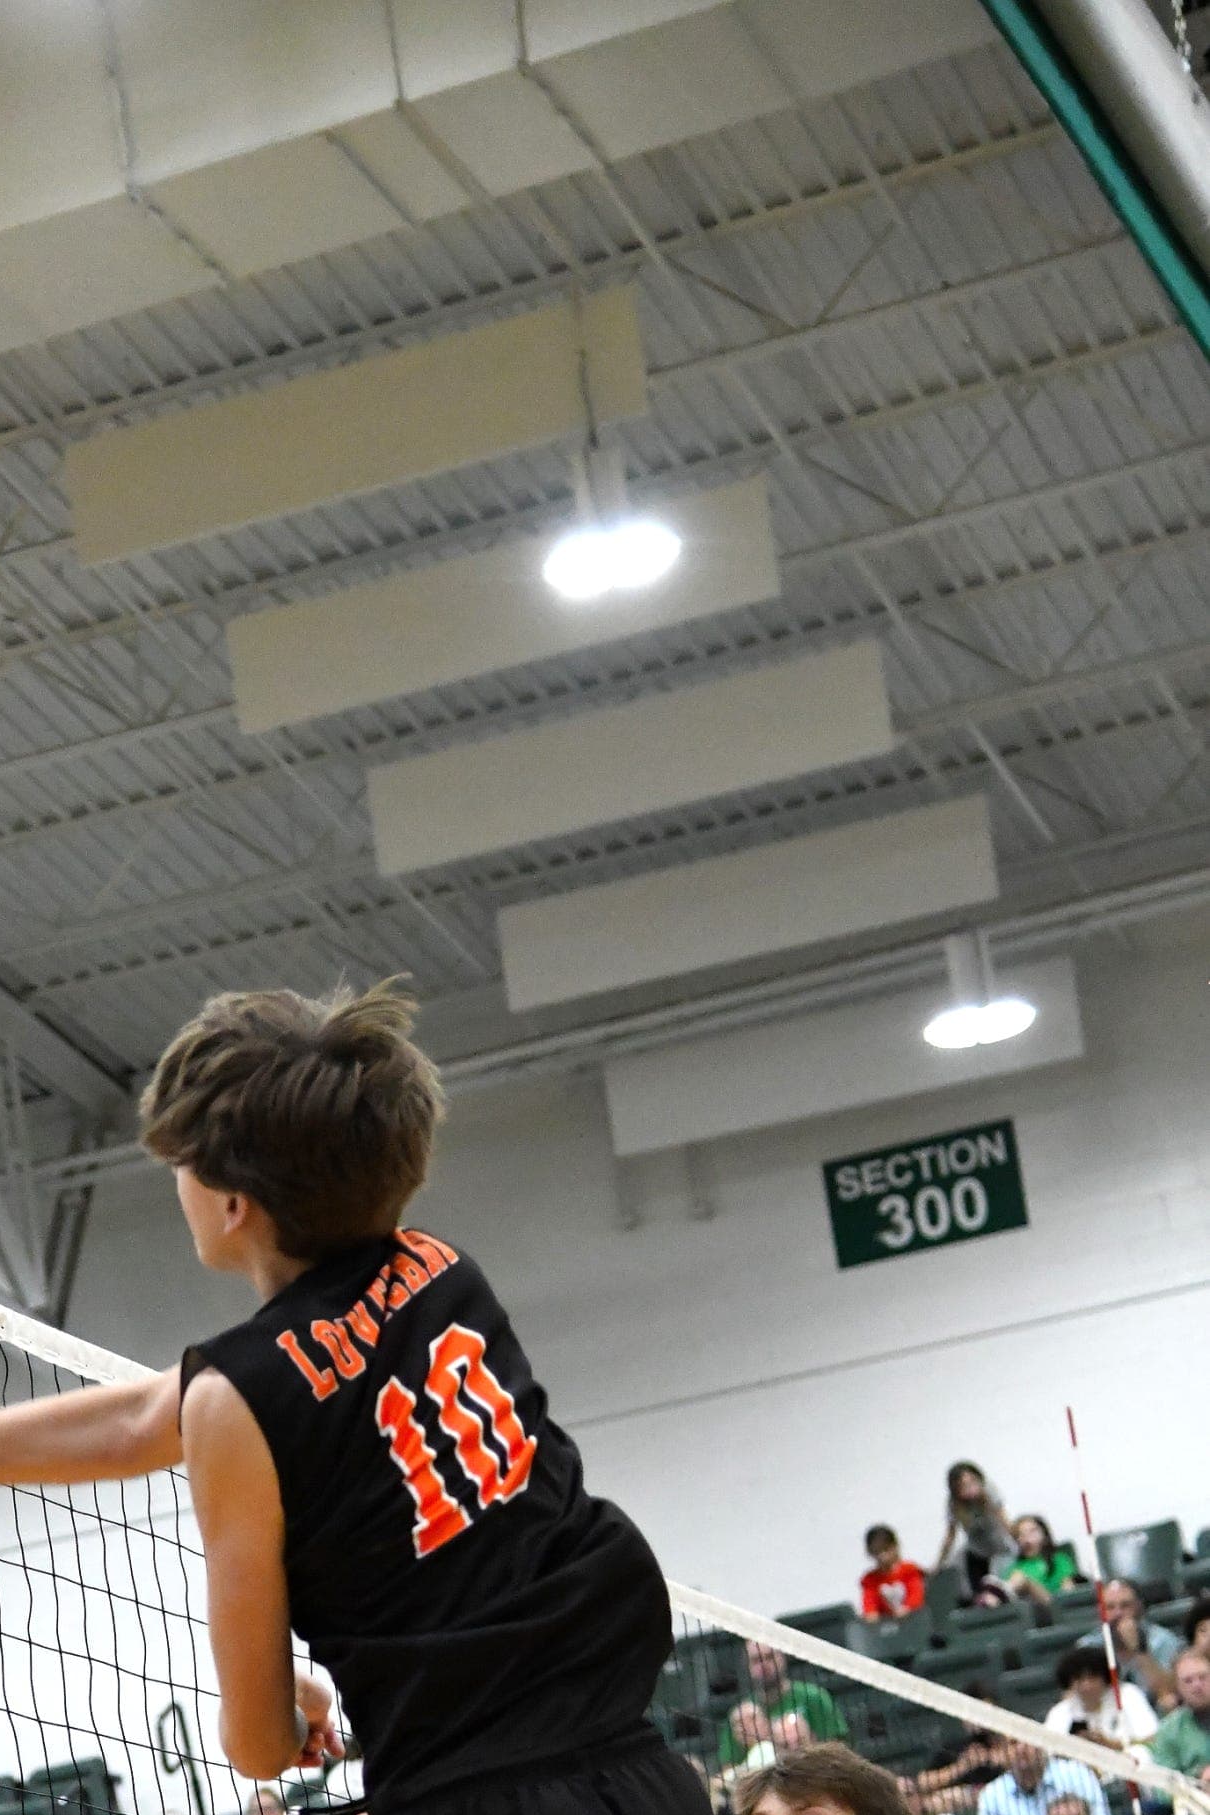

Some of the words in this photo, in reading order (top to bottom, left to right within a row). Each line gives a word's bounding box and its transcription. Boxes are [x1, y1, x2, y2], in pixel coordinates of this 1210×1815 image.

[835, 1130, 1008, 1200] SECTION
[874, 1175, 989, 1249] 300
[374, 1322, 538, 1559] 10
